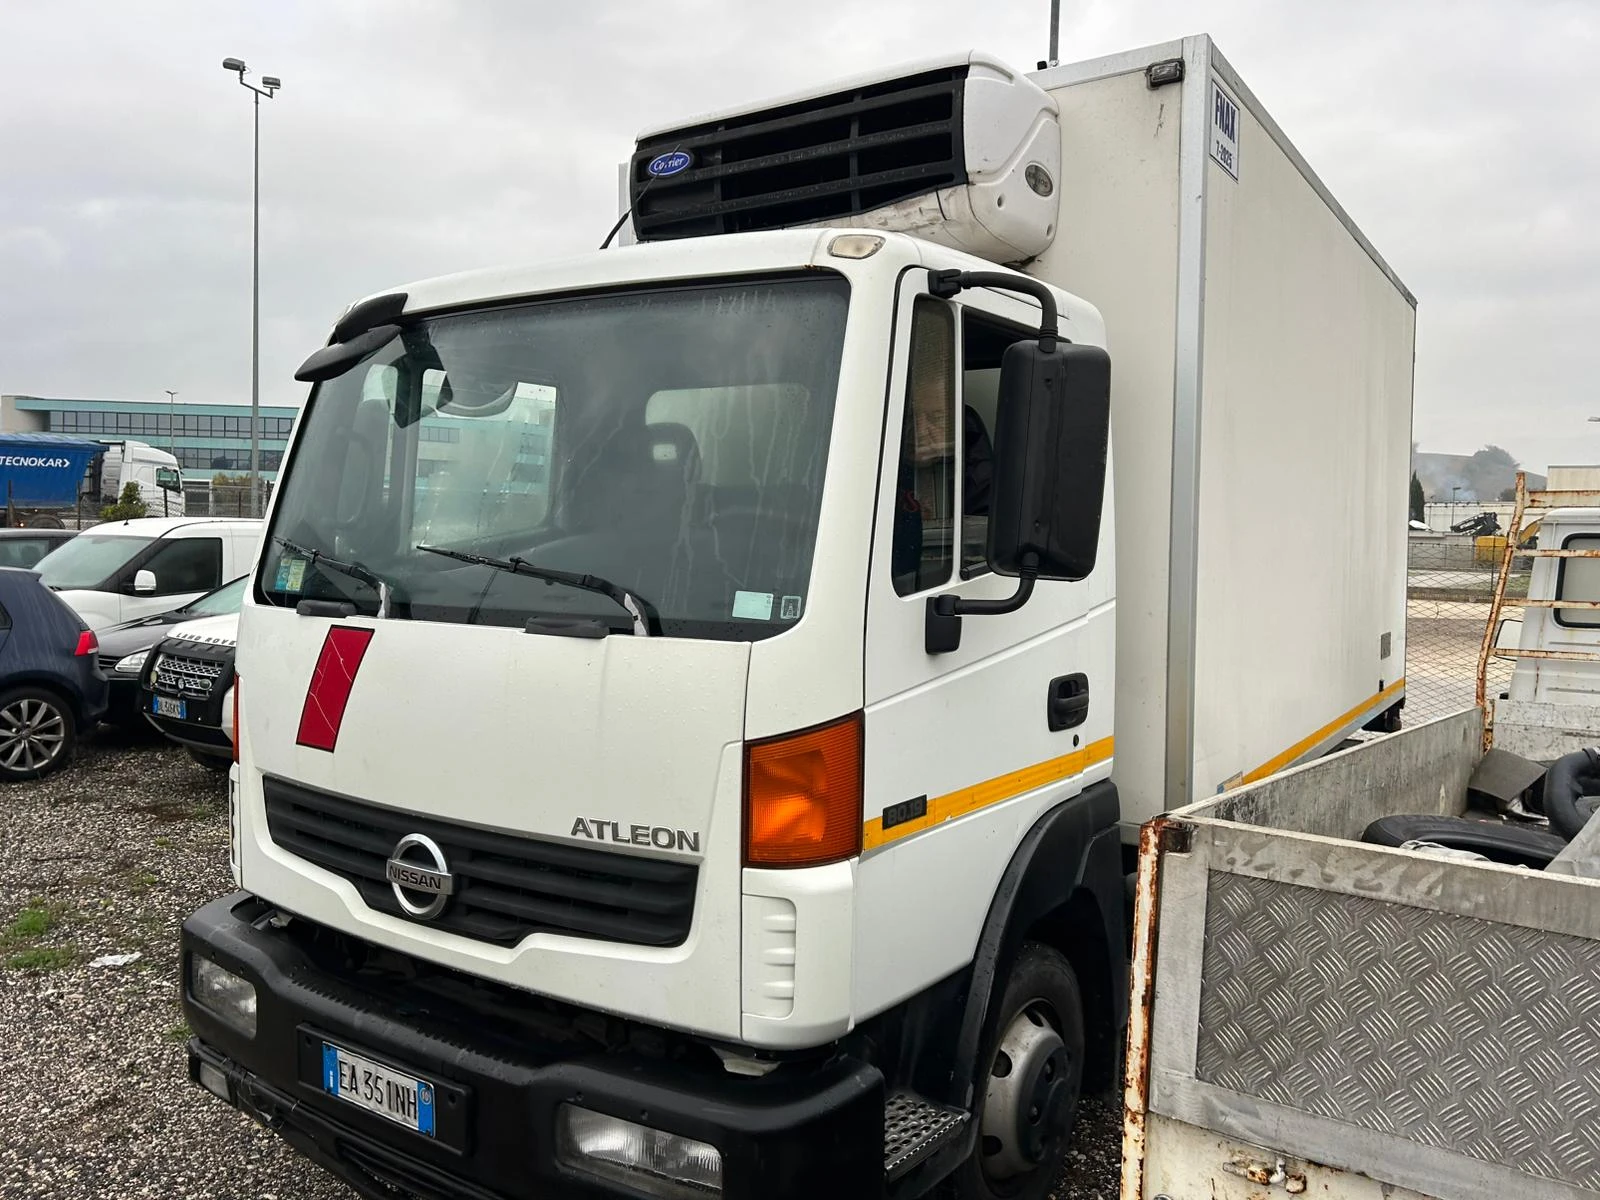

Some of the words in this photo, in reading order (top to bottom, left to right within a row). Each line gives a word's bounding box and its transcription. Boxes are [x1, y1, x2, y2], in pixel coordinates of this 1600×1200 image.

[1215, 89, 1236, 144] FNAX
[0, 455, 63, 468] TECNOKAR
[175, 632, 202, 641] LAND
[570, 816, 700, 852] ATLEON
[389, 864, 441, 890] NISSAN
[339, 1059, 358, 1095] EA
[363, 1069, 417, 1120] 351NH
